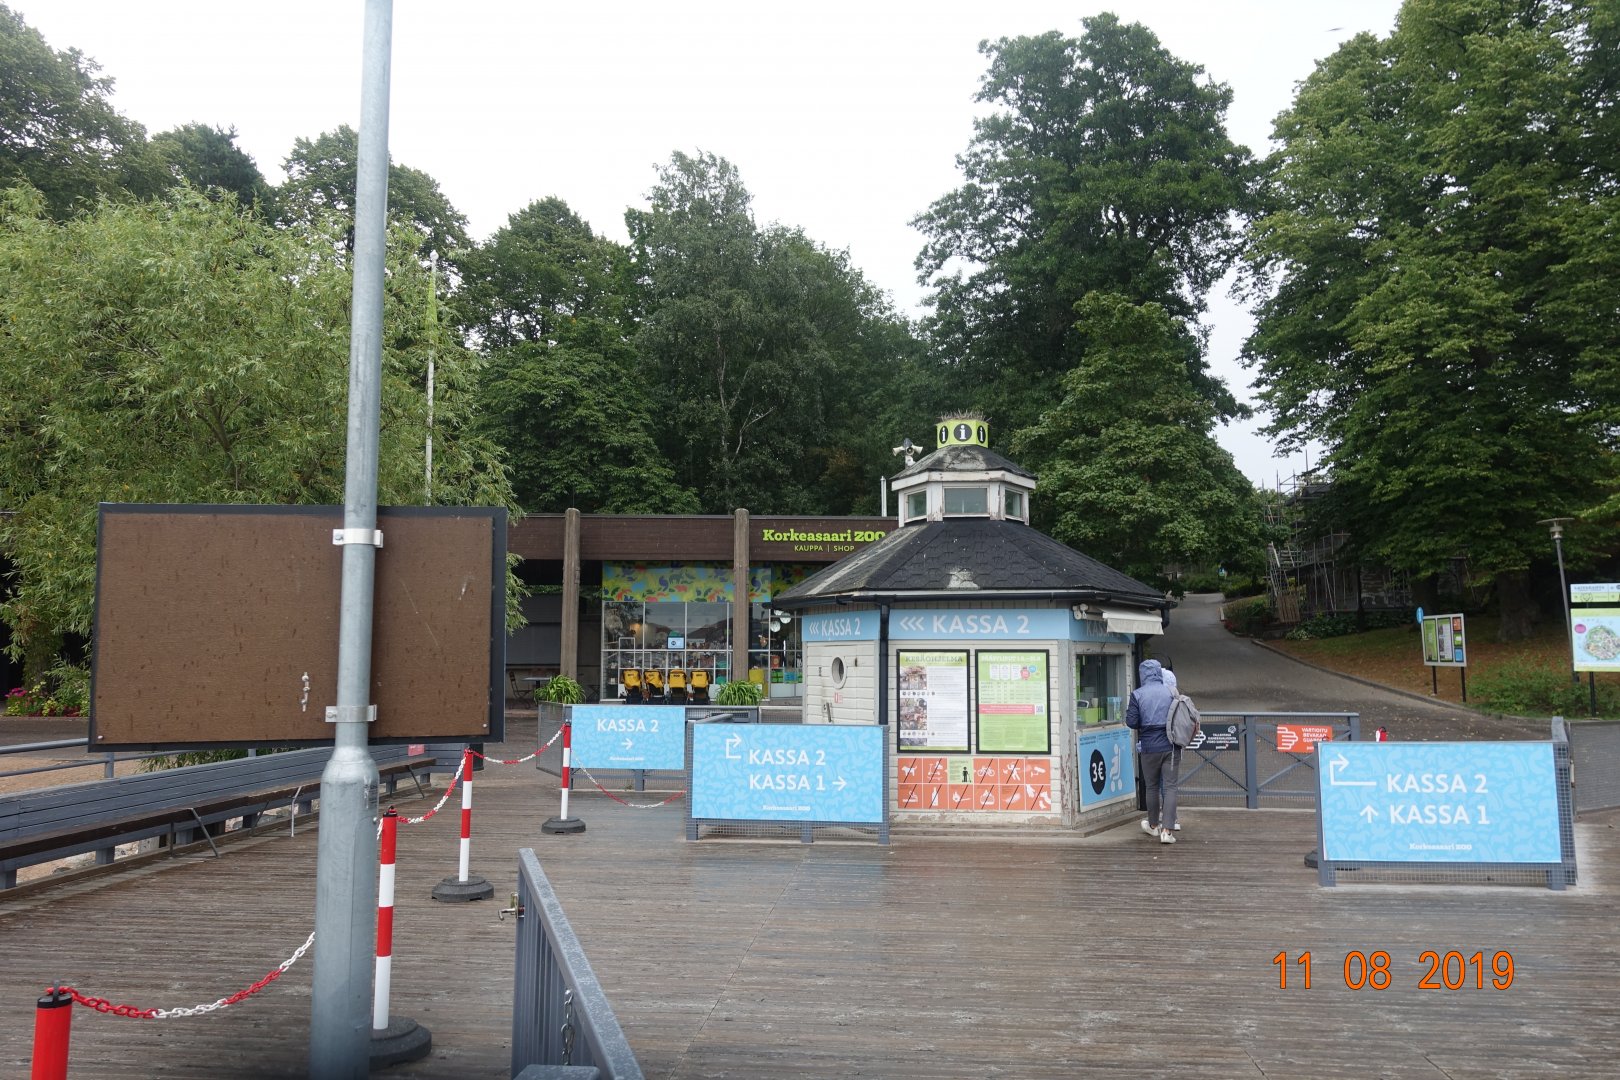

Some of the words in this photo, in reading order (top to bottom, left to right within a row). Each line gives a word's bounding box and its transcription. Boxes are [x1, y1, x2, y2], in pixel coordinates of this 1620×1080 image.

[762, 528, 852, 542] Korkeasaari
[821, 618, 852, 637] KASSA
[854, 617, 861, 635] 2
[932, 615, 1009, 634] KASSA
[1016, 615, 1030, 634] 2
[597, 719, 646, 733] KASSA
[650, 719, 659, 733] 2
[749, 749, 810, 765] KASSA
[815, 749, 826, 766] 2
[1092, 761, 1105, 783] 3€
[749, 774, 811, 791] KASSA
[816, 774, 826, 791] 1
[1386, 773, 1468, 793] KASSA
[1474, 774, 1489, 794] 2
[1389, 804, 1470, 824] KASSA
[1477, 804, 1490, 824] 1
